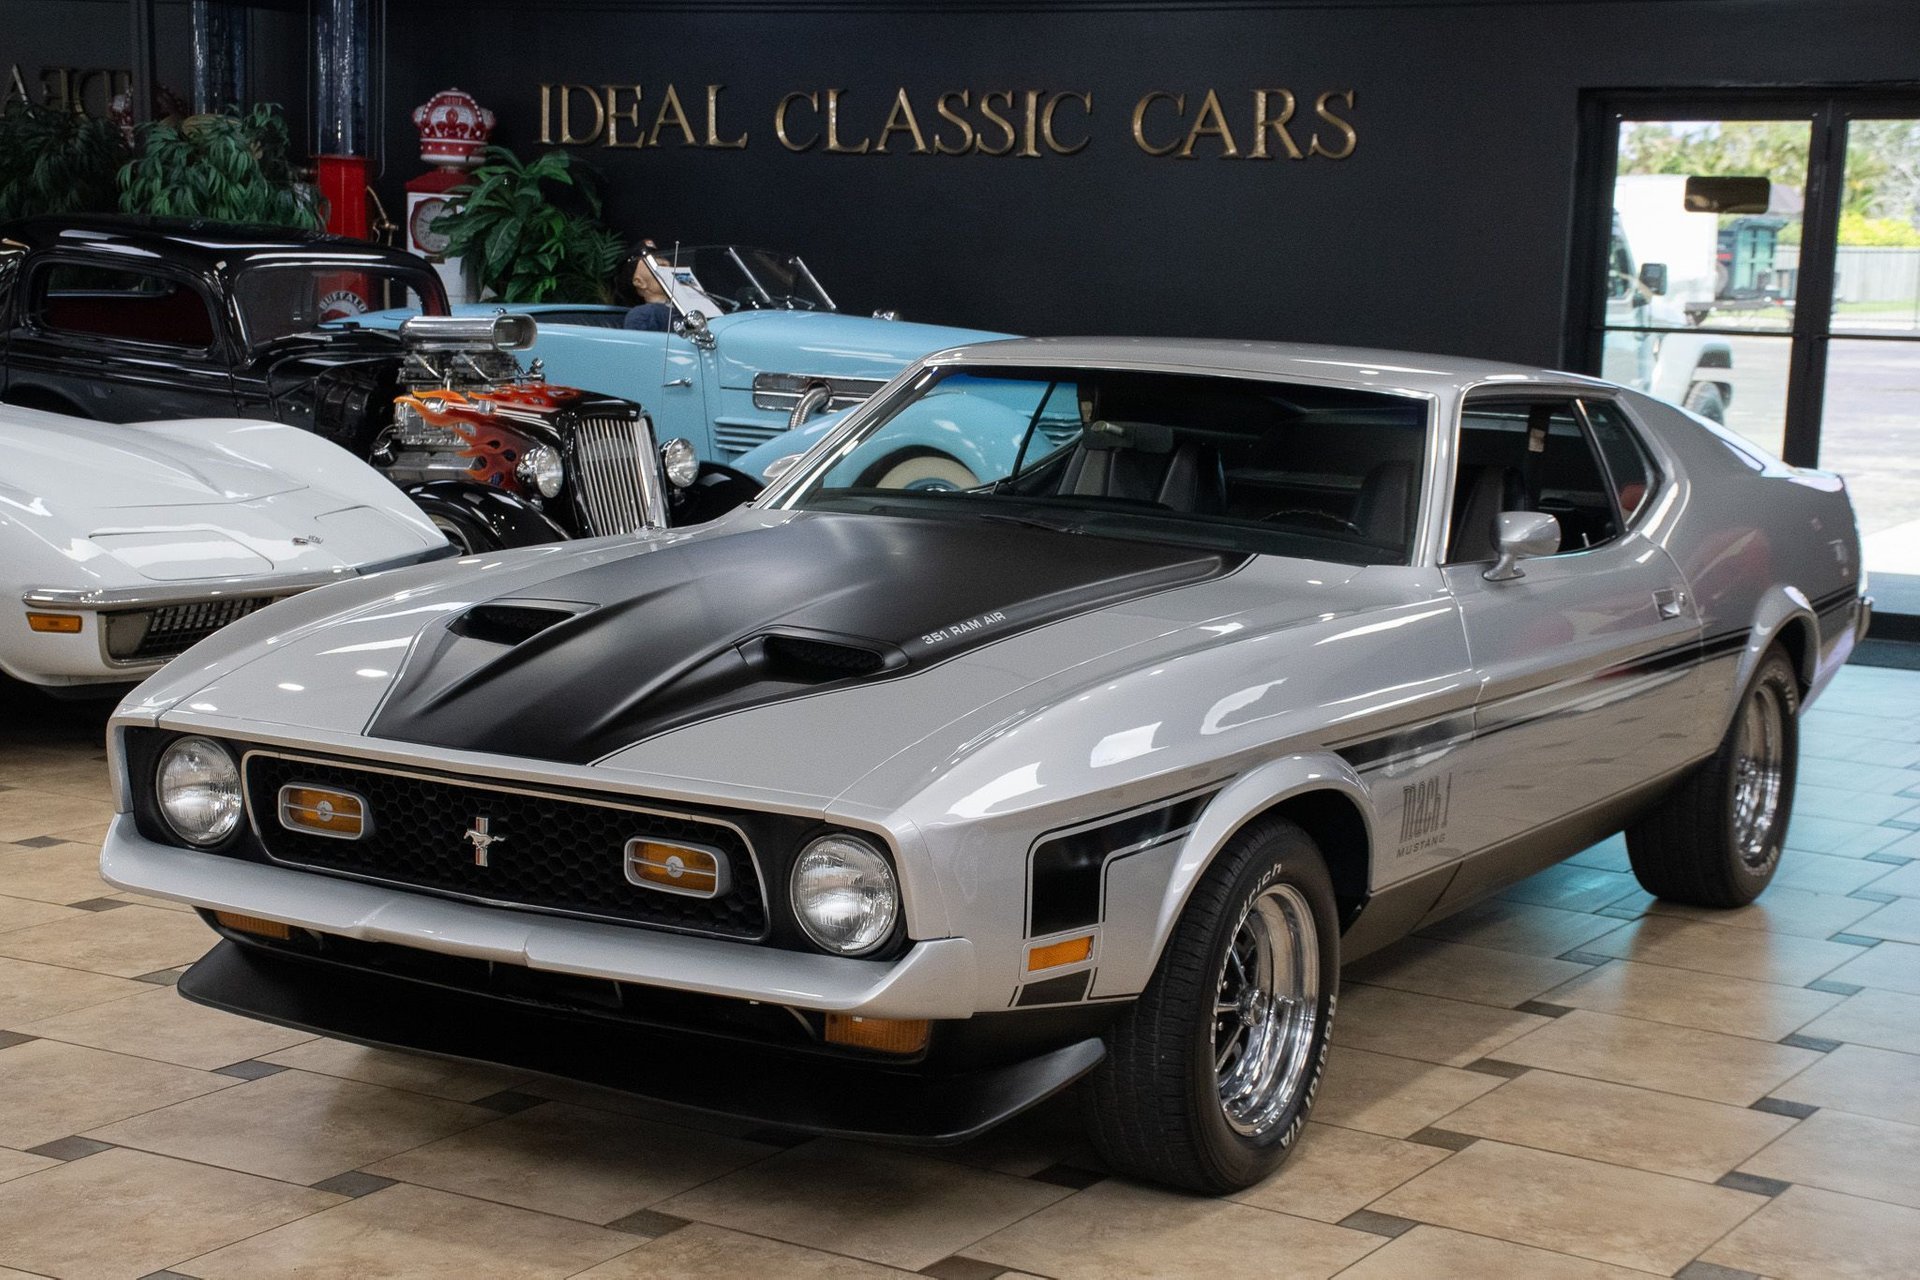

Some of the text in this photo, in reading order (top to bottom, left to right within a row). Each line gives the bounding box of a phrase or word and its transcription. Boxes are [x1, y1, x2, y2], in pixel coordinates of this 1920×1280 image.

[536, 84, 1357, 159] IDEAL CLASSIC CARS
[320, 291, 367, 312] BUFFALO
[922, 611, 1006, 645] 351 RAM AIR
[1397, 833, 1446, 858] MUSTANG
[1280, 994, 1337, 1149] Radial T/A
